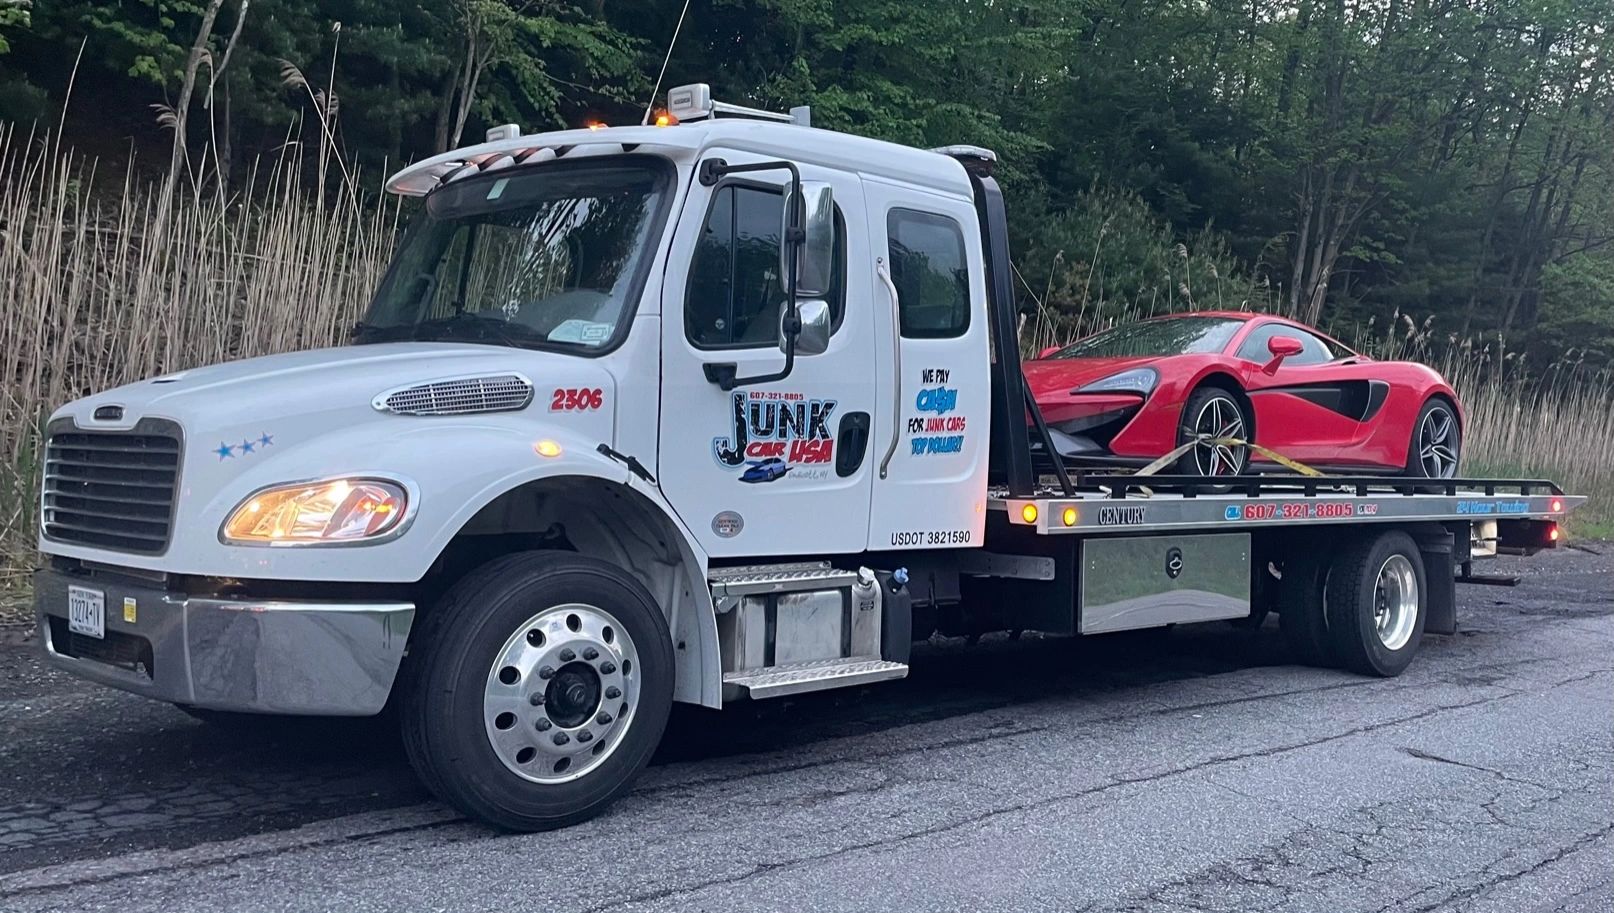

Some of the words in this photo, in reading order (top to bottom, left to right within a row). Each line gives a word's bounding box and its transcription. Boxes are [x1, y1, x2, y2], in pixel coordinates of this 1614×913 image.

[922, 368, 934, 384] WE
[936, 368, 950, 384] PAY
[713, 390, 838, 468] JUNK
[907, 417, 924, 434] FOR
[925, 417, 946, 433] JUNK
[946, 416, 966, 432] CARS
[745, 441, 787, 458] CAR
[788, 439, 834, 464] USA
[911, 437, 928, 455] TOP
[1098, 505, 1147, 525] CENTURY
[1244, 503, 1353, 520] 607-321-8805
[891, 532, 925, 545] USDOT
[927, 531, 971, 545] 3821590
